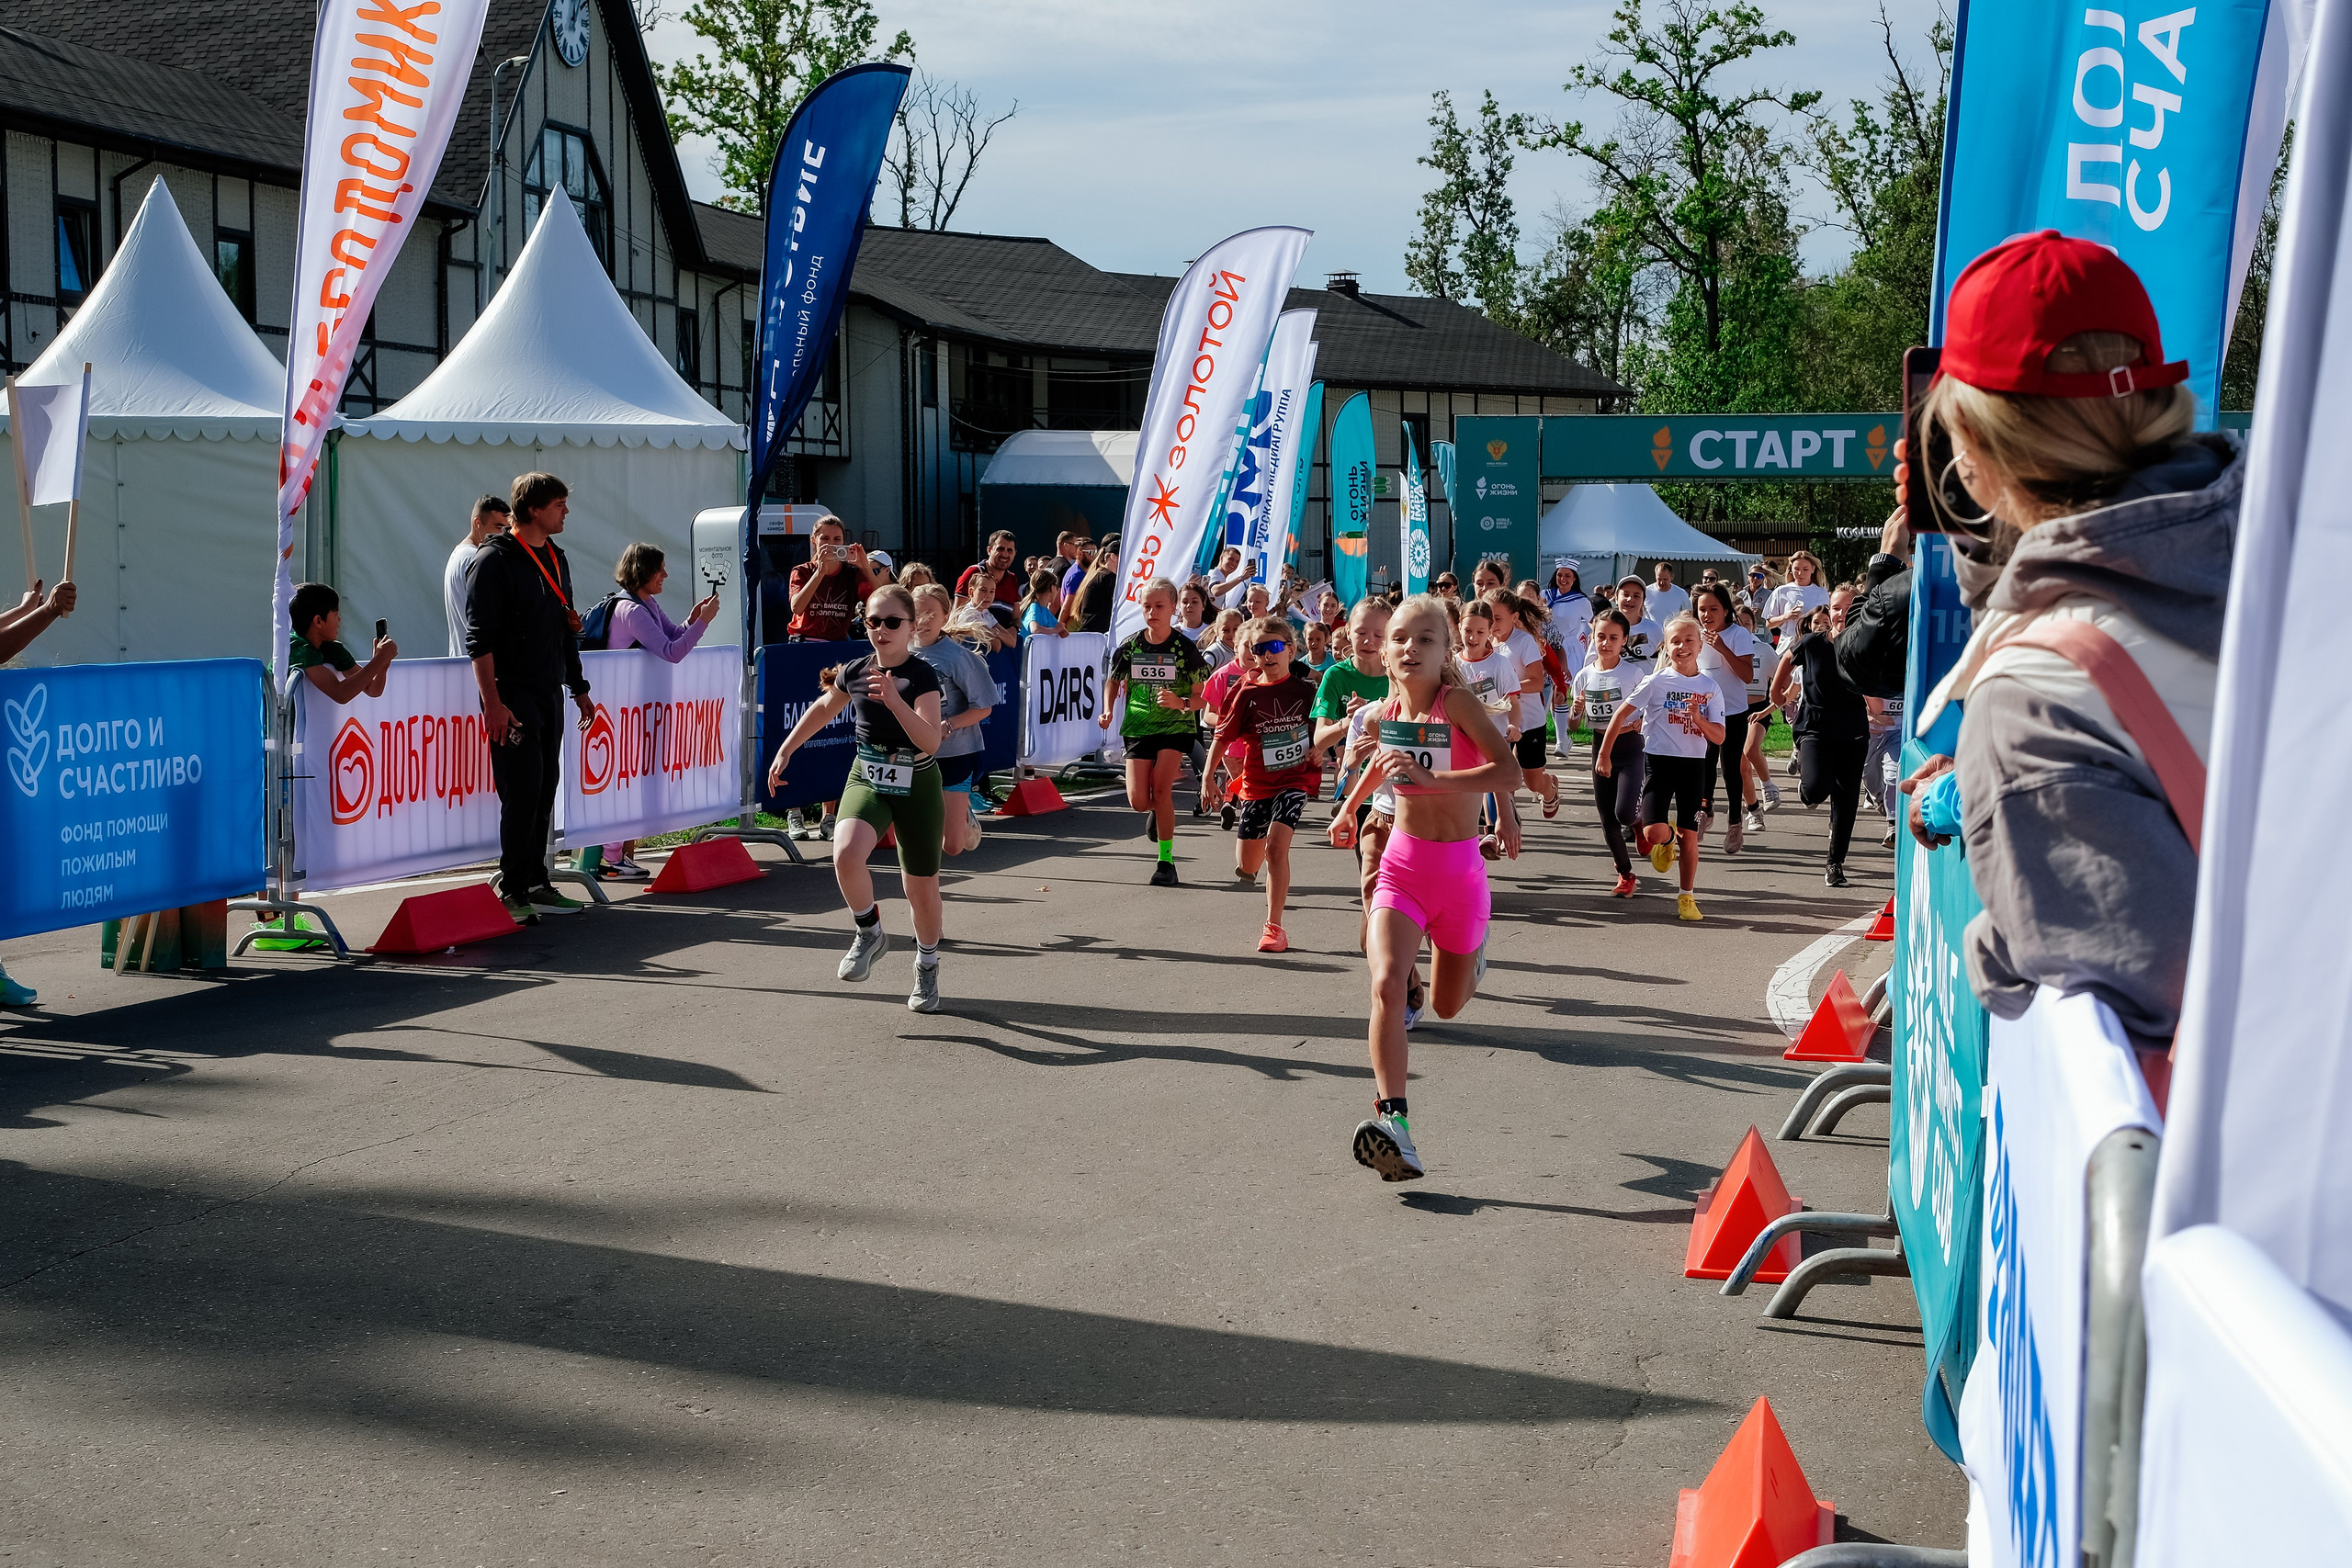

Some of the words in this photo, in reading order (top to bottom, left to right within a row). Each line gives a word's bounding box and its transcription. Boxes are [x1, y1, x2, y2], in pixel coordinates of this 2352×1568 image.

[802, 255, 824, 305] фонд
[1169, 269, 1247, 470] ЗОЛОТОЙ
[1267, 388, 1292, 491] МЕДИАГРУППА
[1689, 429, 1856, 469] СТАРТ
[1348, 466, 1359, 521] ОГОНЬ
[1039, 665, 1095, 725] DARS
[1141, 667, 1166, 678] 636
[1591, 704, 1613, 716] 613
[57, 718, 142, 762] ДОЛГО
[150, 716, 164, 746] И
[617, 697, 725, 790] ДОБРОДОМИК
[1274, 744, 1303, 761] 659
[59, 754, 203, 800] СЧАСТЛИВО
[378, 713, 496, 820] ДОБРОДОМ
[866, 764, 898, 784] 614
[61, 821, 103, 844] ФОНД
[107, 812, 169, 840] ПОМОЩИ
[61, 849, 137, 877] ПОЖИЛЫМ
[61, 884, 115, 910] ЛЮДЯМ
[1931, 1125, 1954, 1268] CLUB
